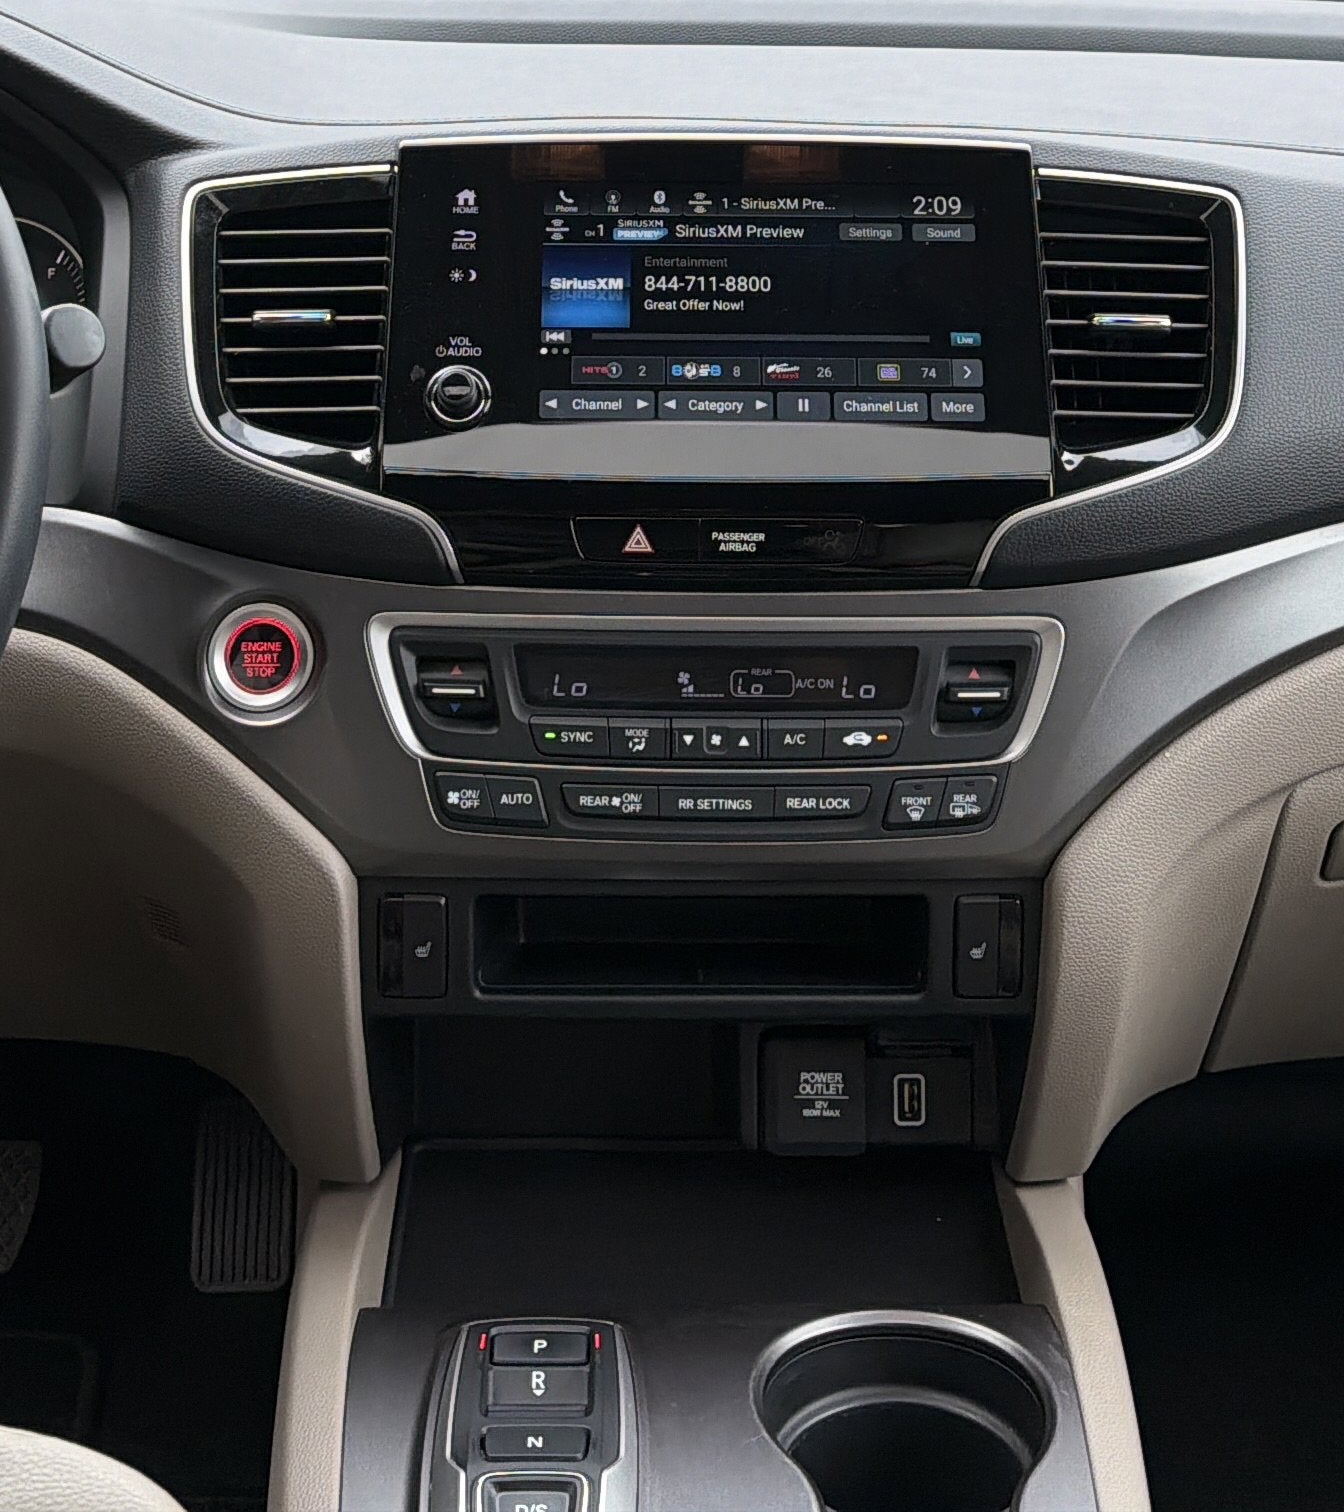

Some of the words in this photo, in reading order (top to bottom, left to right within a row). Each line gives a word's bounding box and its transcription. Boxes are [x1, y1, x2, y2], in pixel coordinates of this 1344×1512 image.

[555, 205, 579, 213] Phone
[607, 205, 619, 213] FM
[649, 205, 670, 214] Audio
[721, 198, 729, 209] 1
[740, 197, 799, 210] SiriusXM
[912, 196, 962, 216] 2:09
[452, 206, 479, 214] HOME
[617, 219, 664, 228] SIRIUSXM
[597, 224, 605, 237] 1
[617, 230, 666, 238] PREVIEW
[675, 225, 742, 239] SiriusXM
[746, 225, 805, 239] Preview
[848, 227, 893, 240] Settings
[926, 228, 961, 239] Sound
[451, 242, 477, 251] BACK
[644, 256, 728, 268] Entertainment
[47, 267, 56, 280] F
[550, 277, 624, 291] SiriusXM
[644, 275, 772, 293] 844-711-8800
[644, 299, 677, 311] Great
[679, 299, 709, 311] Offer
[713, 299, 745, 311] Now!
[449, 337, 472, 346] VOL
[956, 336, 974, 345] Live
[446, 347, 482, 357] AUDIO
[638, 365, 647, 377] 2
[732, 366, 741, 378] 8
[816, 367, 833, 379] 26
[921, 367, 937, 379] 74
[572, 398, 623, 411] Channel
[688, 399, 744, 414] Category
[843, 400, 893, 413] Channel
[896, 401, 919, 413] List
[942, 401, 975, 413] More
[712, 531, 766, 542] PASSENGER
[719, 542, 757, 552] AIRBAG
[241, 641, 282, 652] ENGINE
[243, 653, 279, 664] START
[246, 667, 276, 678] STOP
[751, 668, 773, 676] REAR
[552, 674, 588, 697] Lo
[795, 678, 815, 688] A/C
[817, 679, 834, 689] ON
[841, 675, 876, 699] Lo
[560, 731, 594, 743] SYNC
[624, 729, 649, 737] MODE
[783, 733, 806, 745] A/C
[500, 793, 533, 805] AUTO
[579, 795, 609, 807] REAR
[786, 797, 817, 809] REAR
[819, 797, 851, 810] LOCK
[901, 796, 932, 806] FRONT
[953, 793, 977, 803] REAR
[459, 799, 481, 810] OFF
[621, 803, 643, 814] OFF
[678, 798, 695, 811] RR
[697, 799, 753, 811] SETTINGS
[800, 1072, 843, 1083] POWER
[798, 1083, 844, 1095] OUTLET
[822, 1109, 841, 1118] MAX
[533, 1339, 548, 1354] P
[531, 1370, 546, 1389] R
[526, 1436, 543, 1449] N
